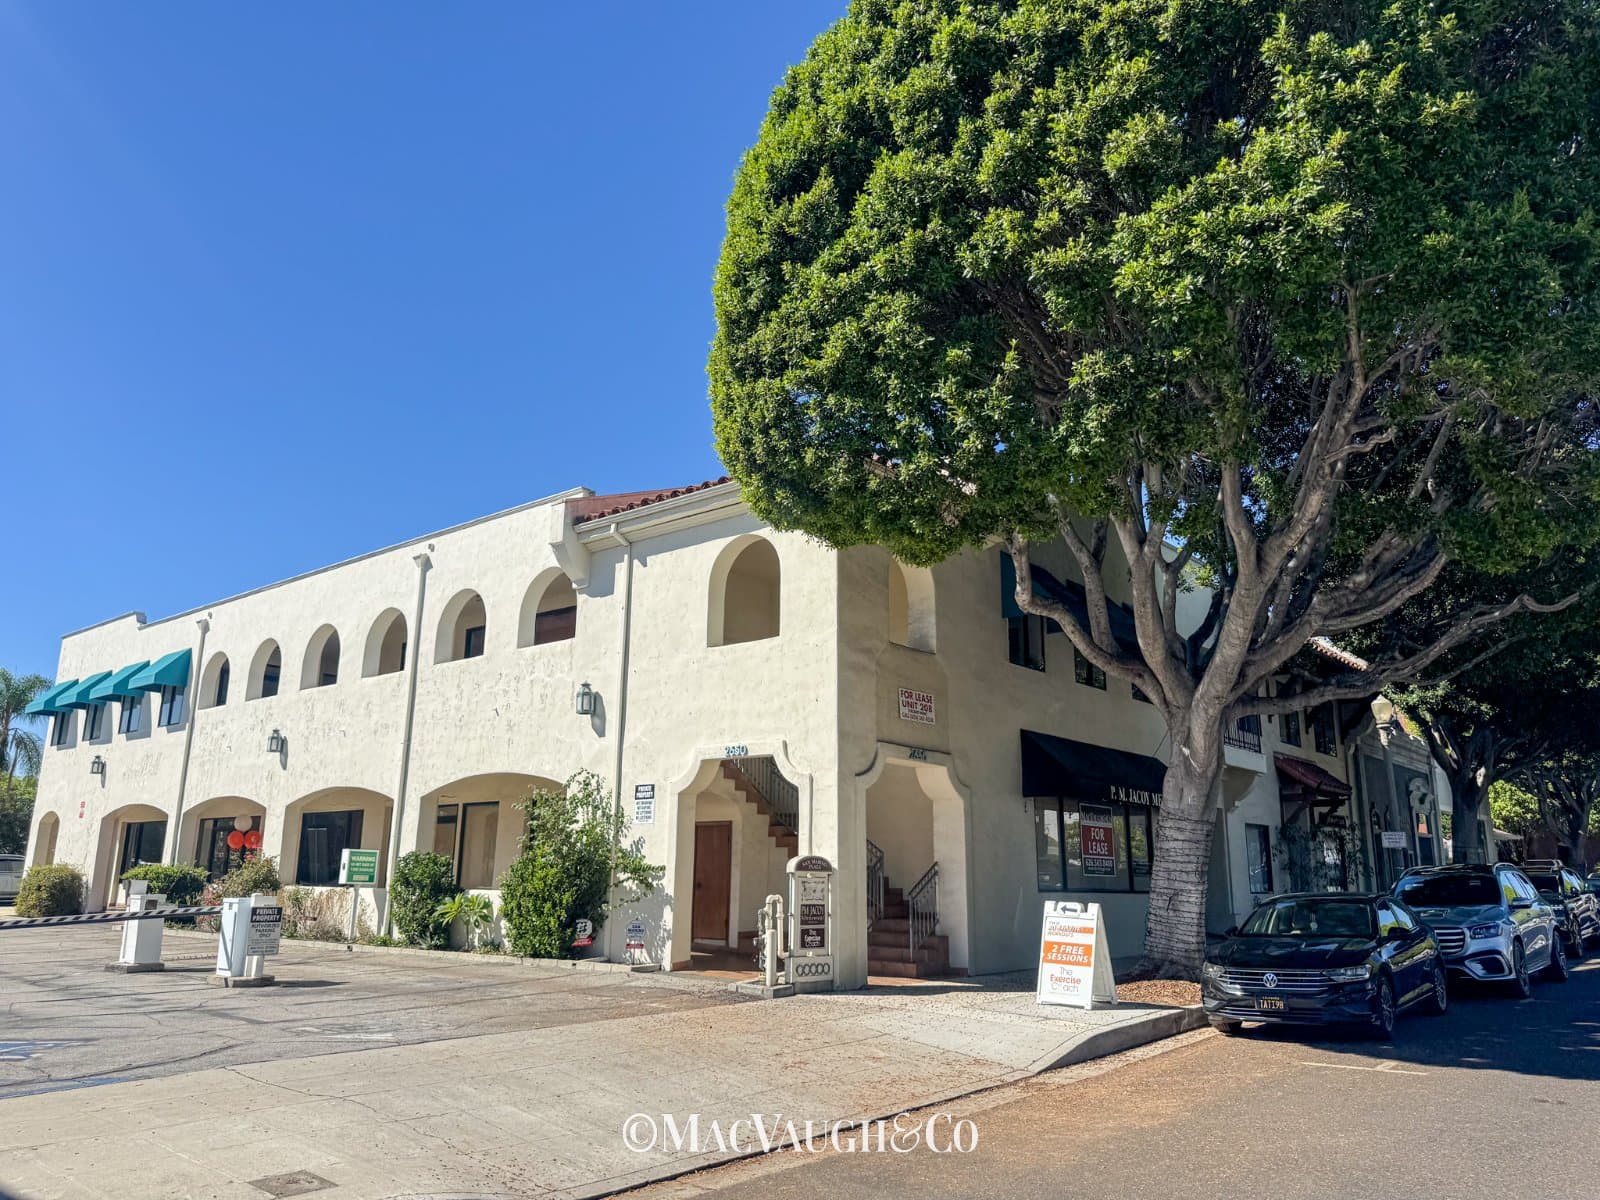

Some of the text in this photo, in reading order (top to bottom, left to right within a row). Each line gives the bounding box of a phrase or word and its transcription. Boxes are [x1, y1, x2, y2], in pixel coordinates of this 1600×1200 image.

[900, 689, 933, 705] FOR LEASE
[901, 700, 918, 710] UNIT
[1110, 785, 1118, 800] P.
[1118, 786, 1128, 801] M.
[1129, 788, 1150, 806] JACOY
[1090, 827, 1105, 841] FOR
[1088, 841, 1109, 855] LEASE
[1051, 944, 1085, 955] 2 FREE
[1047, 952, 1089, 963] SESSIONS
[1059, 966, 1073, 976] The
[1050, 973, 1082, 985] Exercise
